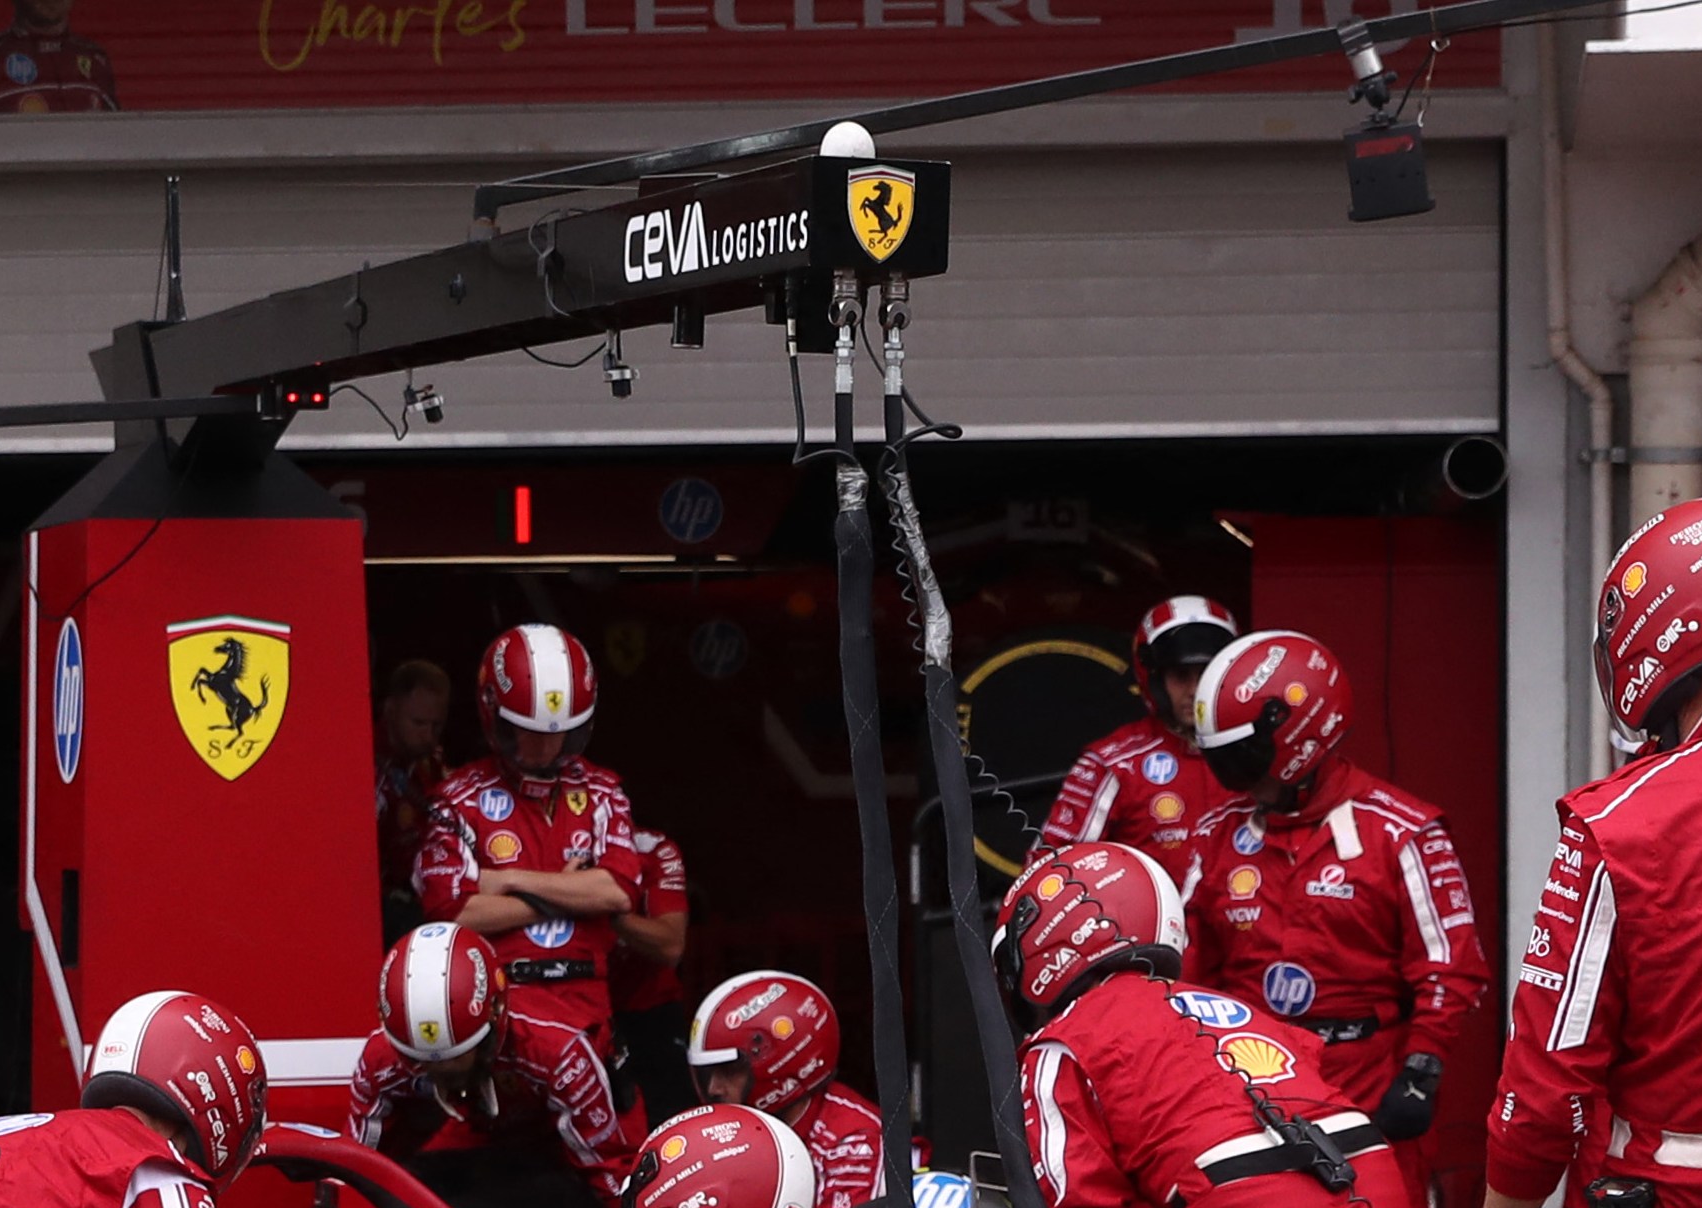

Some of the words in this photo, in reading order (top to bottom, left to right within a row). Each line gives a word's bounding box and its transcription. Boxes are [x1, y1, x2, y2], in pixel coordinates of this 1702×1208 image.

[712, 208, 810, 267] LOGISTICS
[665, 480, 720, 541] hp
[1616, 614, 1647, 658] RICHARD
[1646, 584, 1675, 616] MILLE
[1145, 750, 1176, 785] hp
[482, 787, 513, 822] hp
[1554, 842, 1583, 870] EVA
[1265, 961, 1312, 1017] hp
[1175, 990, 1247, 1030] hp
[701, 1120, 742, 1138] PERONI
[675, 1160, 705, 1183] MILLE
